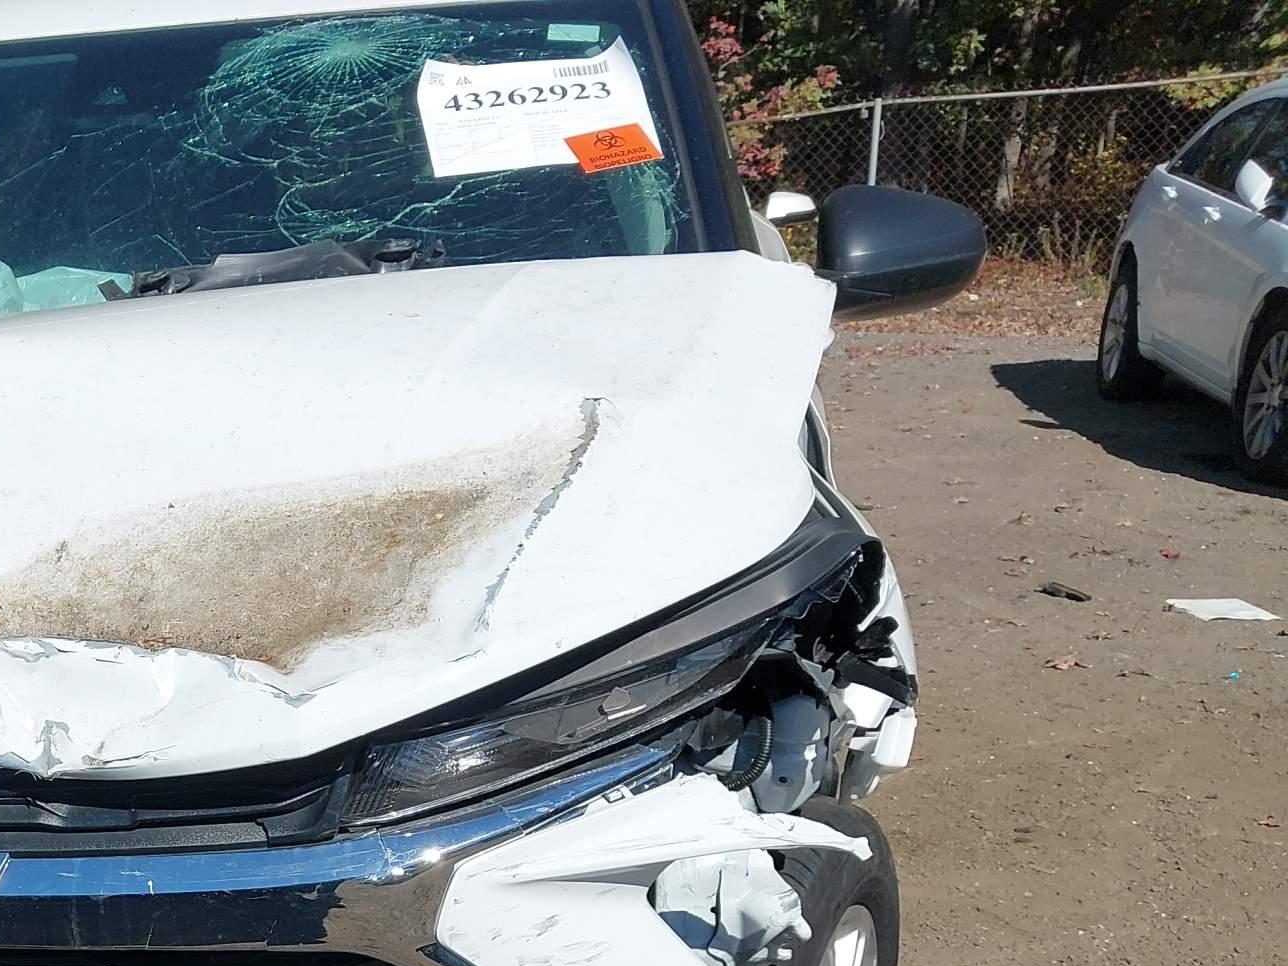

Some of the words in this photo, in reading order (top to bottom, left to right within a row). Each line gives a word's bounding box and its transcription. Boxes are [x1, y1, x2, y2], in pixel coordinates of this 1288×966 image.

[443, 81, 612, 112] 43262923
[589, 146, 648, 164] BIOHAZARD
[594, 153, 652, 170] BIOPELIGRO
